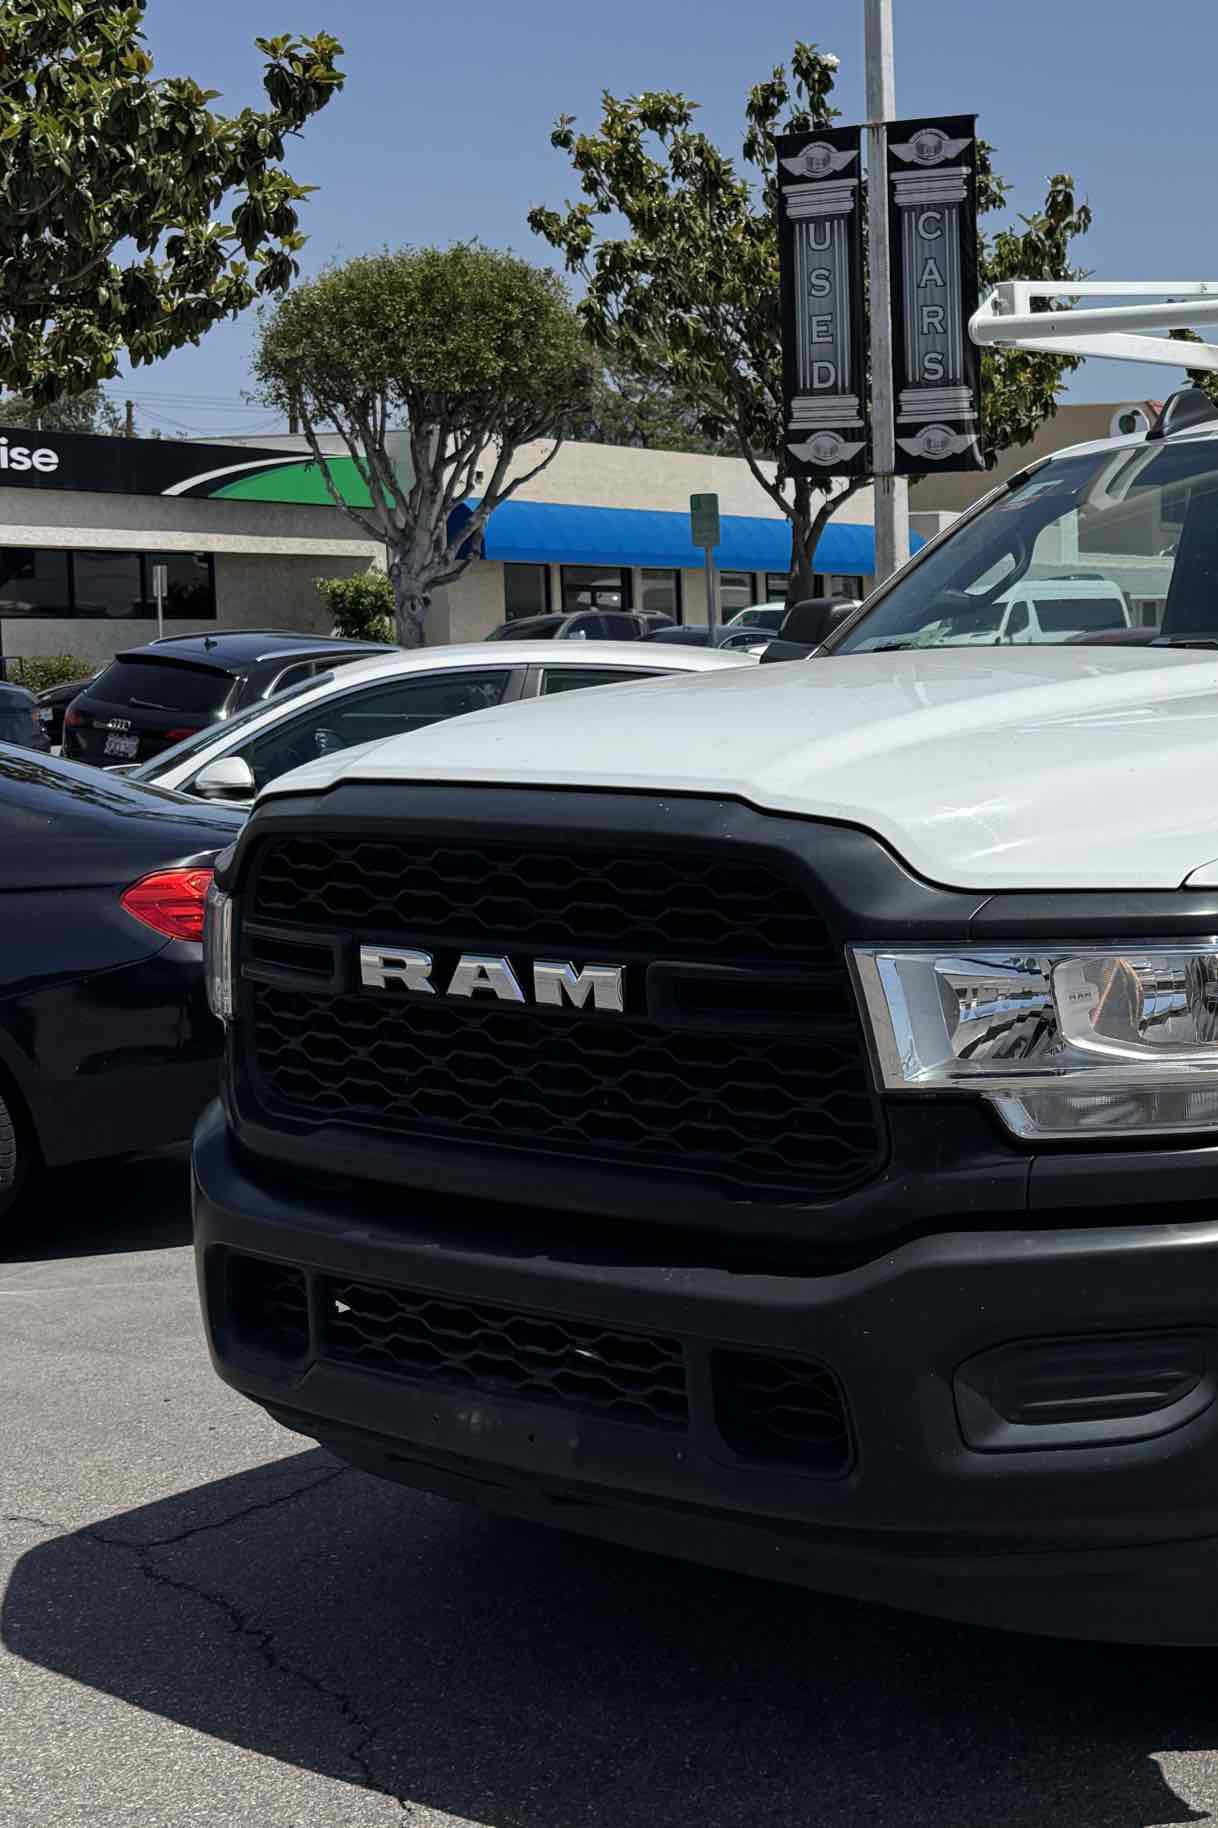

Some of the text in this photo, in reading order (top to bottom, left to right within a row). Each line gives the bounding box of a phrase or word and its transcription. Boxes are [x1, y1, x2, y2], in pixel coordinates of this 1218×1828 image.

[808, 222, 836, 390] USED
[917, 211, 945, 383] CARS
[0, 436, 59, 473] ise
[359, 944, 627, 1012] RAM
